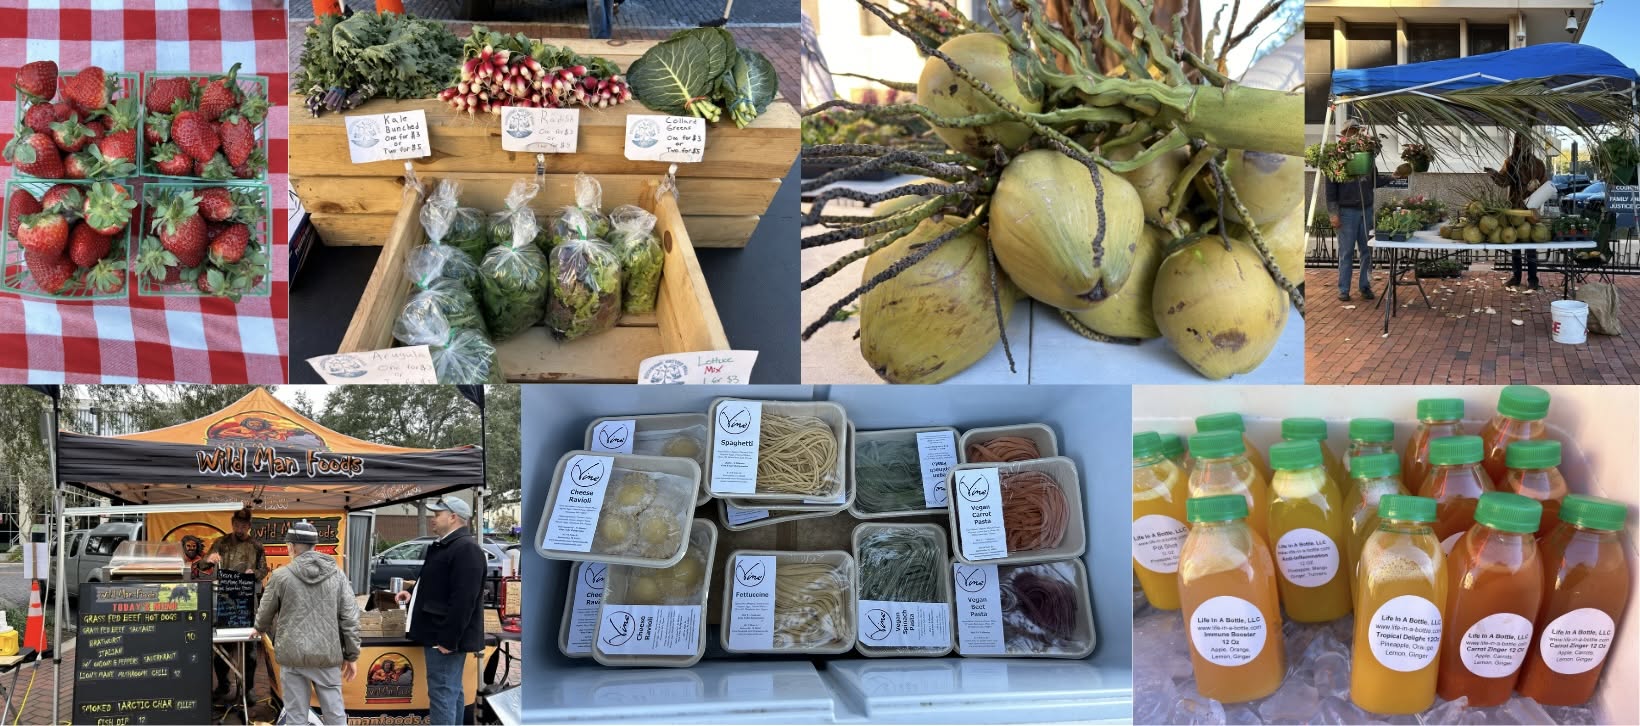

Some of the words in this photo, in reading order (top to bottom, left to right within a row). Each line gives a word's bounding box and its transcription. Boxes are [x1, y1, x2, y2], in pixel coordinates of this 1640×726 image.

[384, 115, 407, 124] Kale
[386, 122, 419, 134] Bunched
[411, 131, 420, 140] $3
[698, 356, 734, 366] Lettuce
[704, 365, 724, 374] Mix
[198, 448, 247, 478] Wild
[253, 447, 300, 478] Man
[306, 450, 364, 478] Foods
[112, 603, 150, 611] TODAY'S
[154, 602, 178, 610] MENU
[636, 616, 646, 640] Cheese
[644, 616, 654, 640] Ravioli
[1376, 632, 1402, 640] Tropical
[1403, 634, 1426, 642] Delight
[98, 648, 124, 658] ITALIAN
[1409, 652, 1428, 660] Ginger
[121, 700, 150, 710] ARCTIC
[152, 700, 172, 708] CHAR
